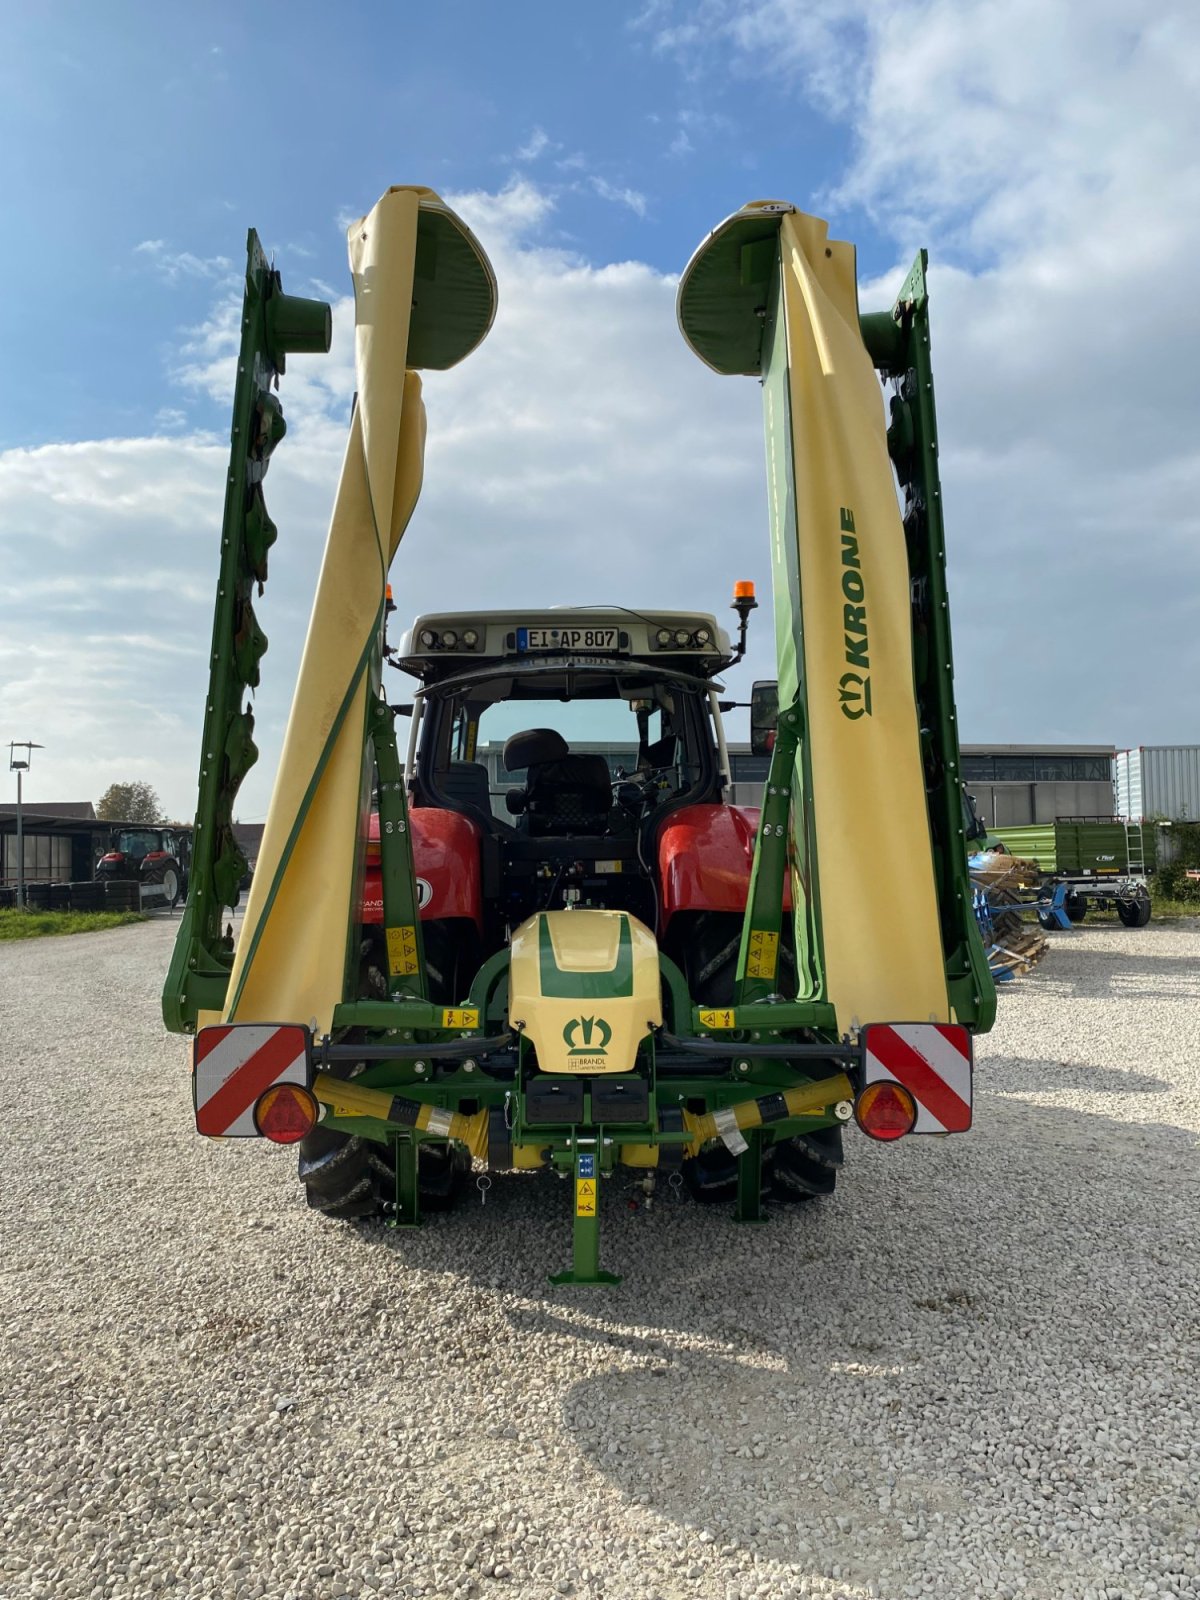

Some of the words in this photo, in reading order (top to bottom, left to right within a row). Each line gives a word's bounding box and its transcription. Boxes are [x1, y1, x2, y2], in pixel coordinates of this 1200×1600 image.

[839, 507, 870, 669] KRONE
[528, 631, 548, 648] EI
[560, 631, 581, 648] AP
[584, 631, 614, 647] 807
